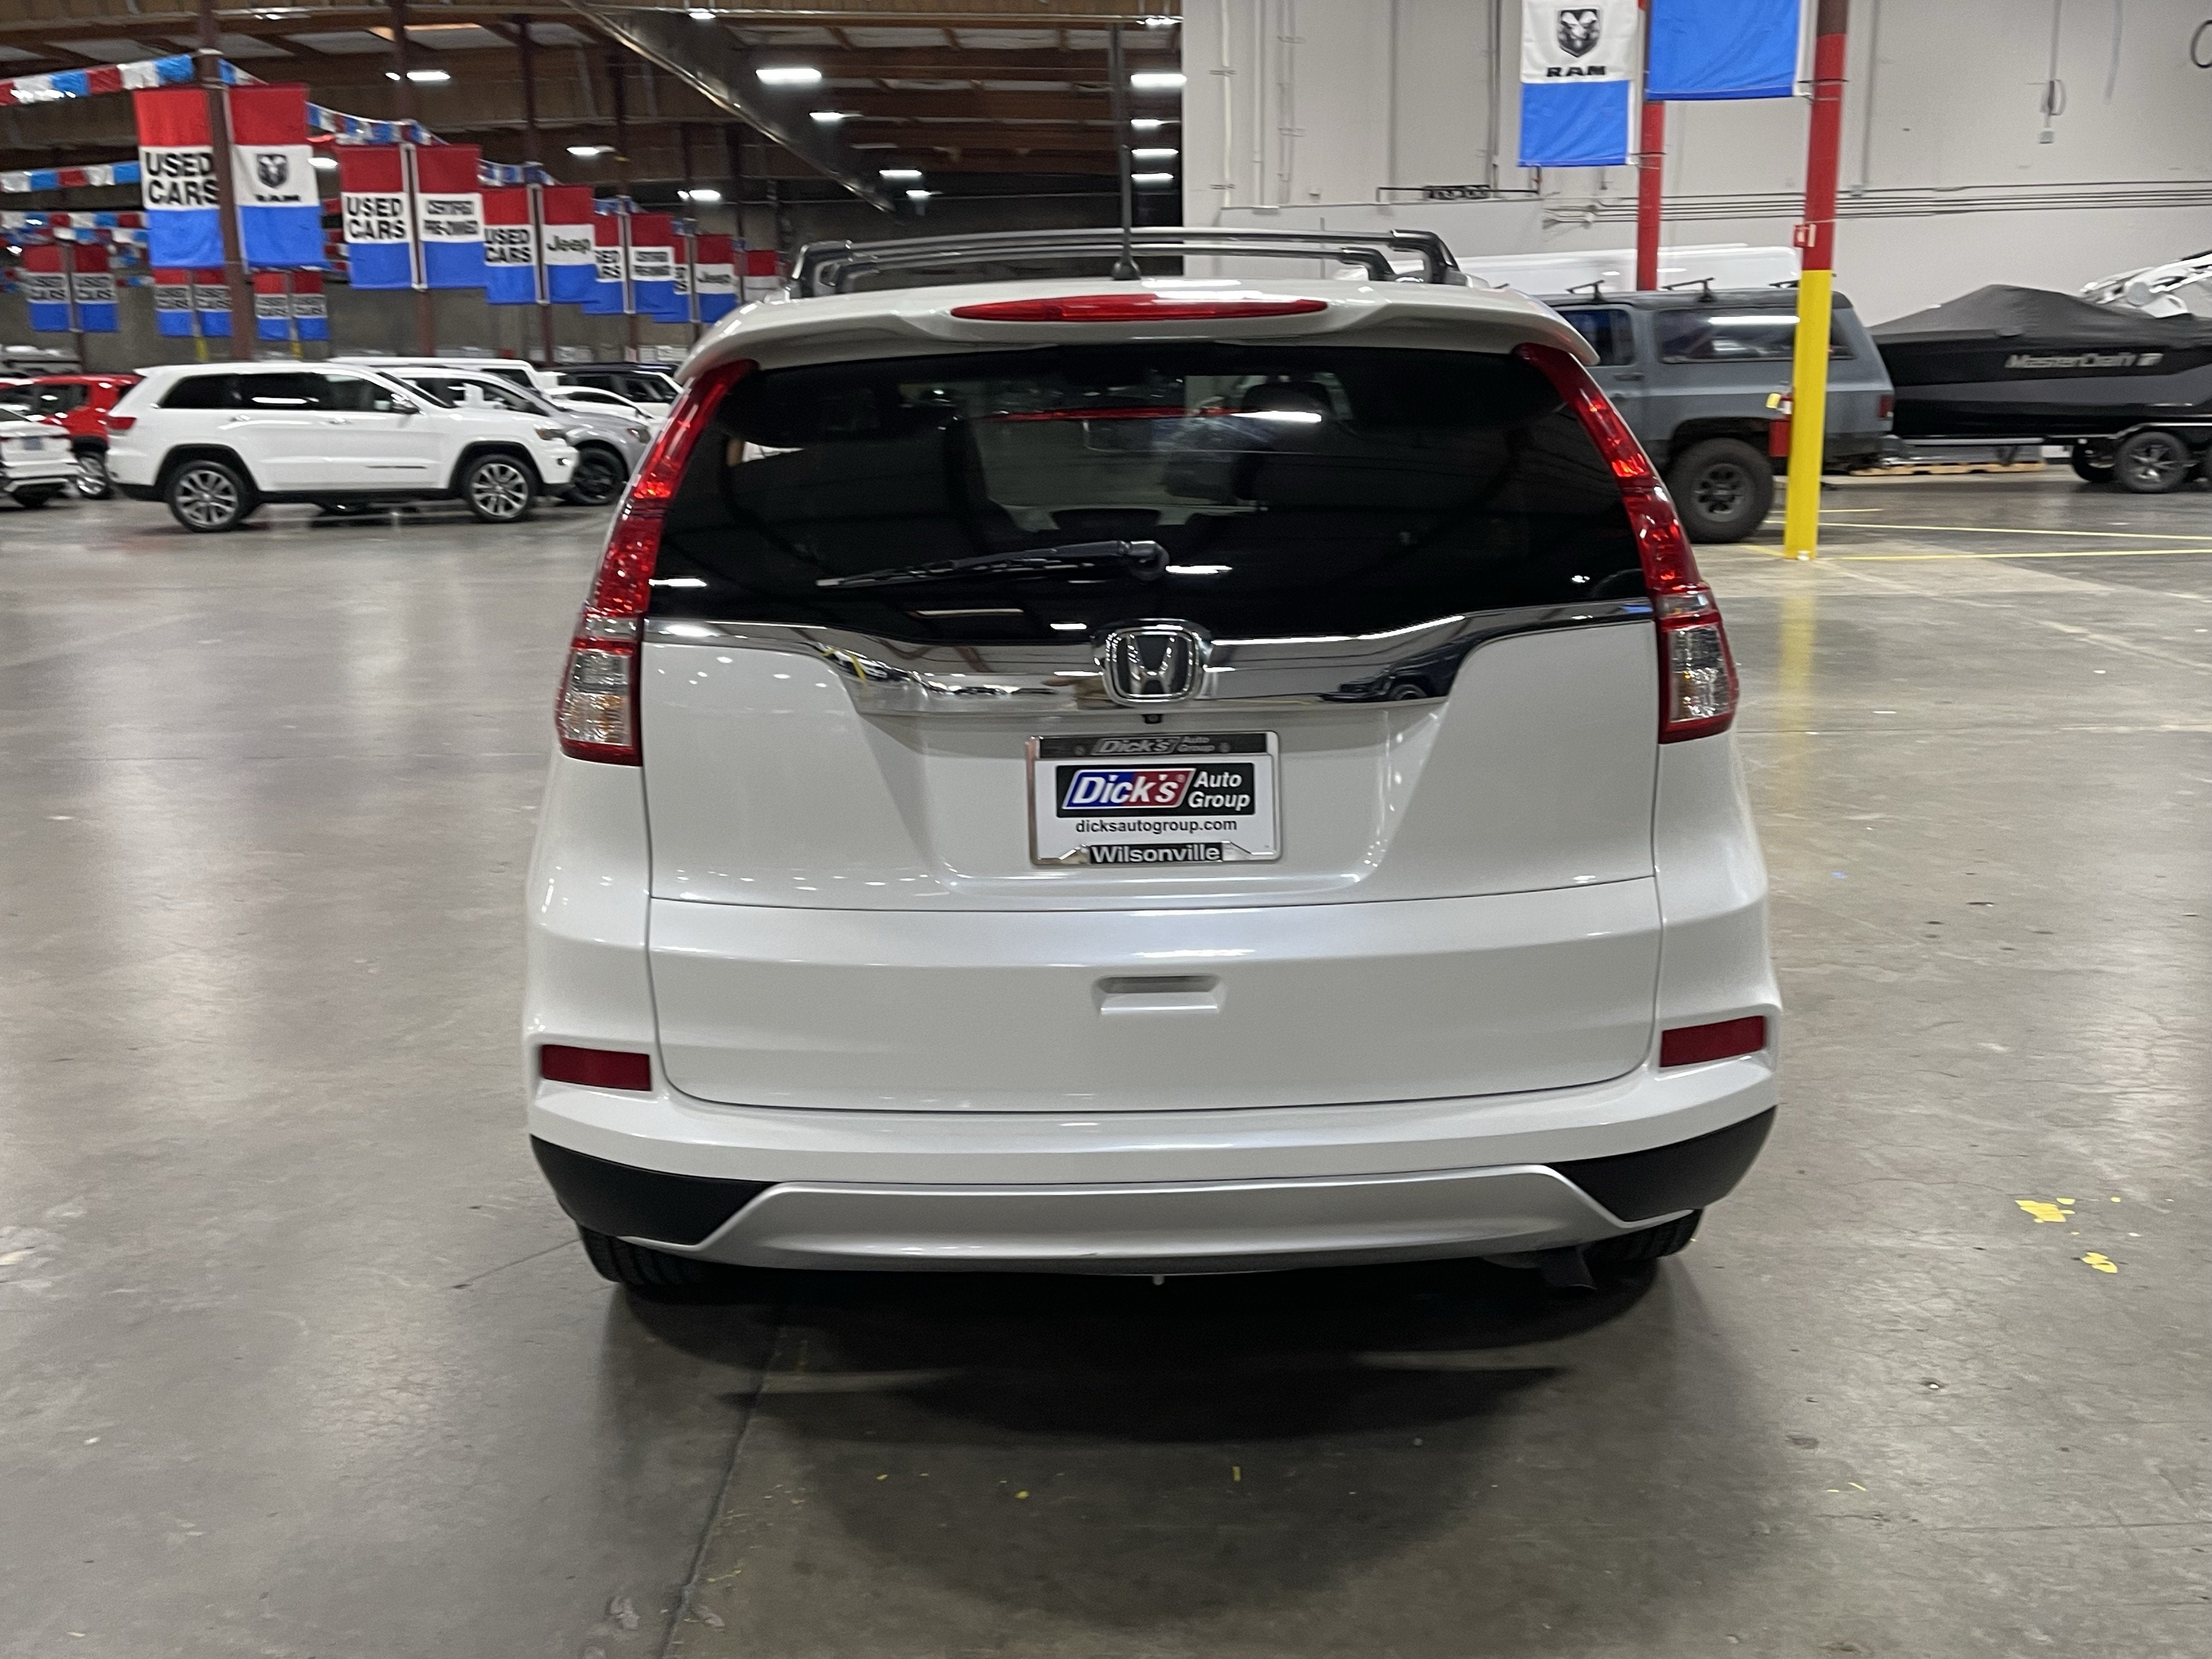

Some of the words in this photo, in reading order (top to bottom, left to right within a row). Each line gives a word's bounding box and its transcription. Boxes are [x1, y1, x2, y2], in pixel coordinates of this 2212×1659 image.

[1546, 66, 1605, 77] RAM
[145, 152, 213, 177] USED
[149, 179, 218, 205] CARS
[347, 196, 403, 217] USED
[349, 219, 406, 239] CARS
[484, 228, 530, 244] USED
[546, 235, 591, 254] Jeep
[487, 247, 531, 262] CARS
[1099, 739, 1170, 753] Dick's
[1072, 774, 1178, 804] Dick's
[1193, 771, 1242, 788] Auto
[1188, 791, 1251, 811] Group
[1076, 820, 1237, 834] dicksautogroup.com
[1091, 844, 1220, 863] Wilsonville
